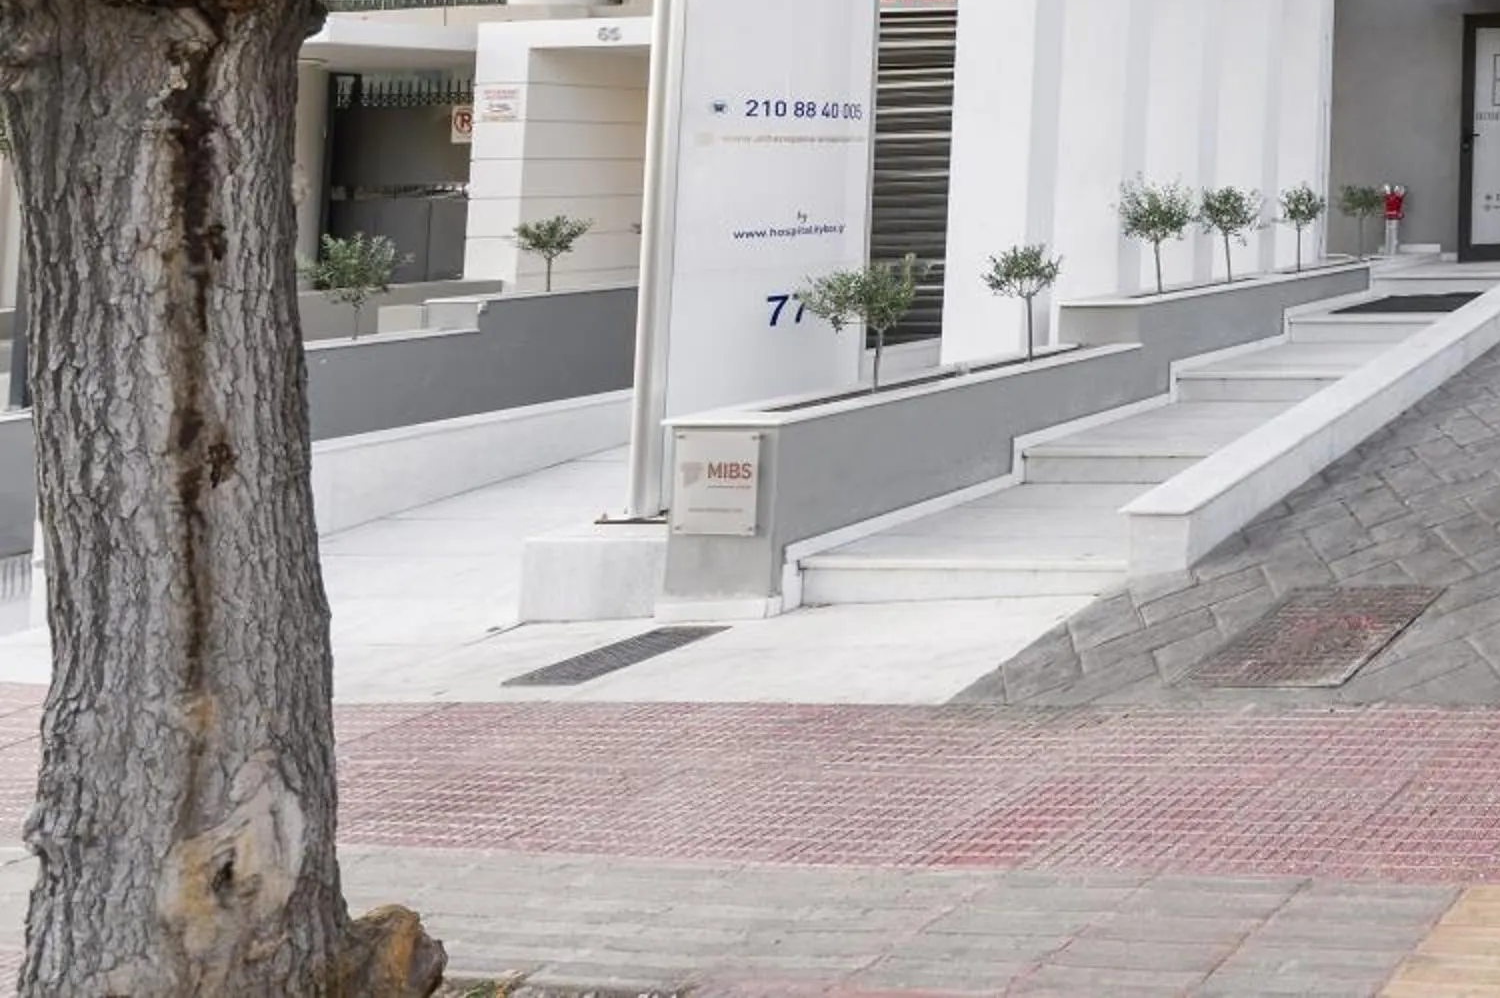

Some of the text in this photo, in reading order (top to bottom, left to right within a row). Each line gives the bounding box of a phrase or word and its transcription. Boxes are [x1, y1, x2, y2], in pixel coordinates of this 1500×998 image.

[745, 99, 787, 118] 210
[793, 101, 817, 118] 88
[821, 102, 839, 119] 40
[707, 462, 752, 479] MIBS
